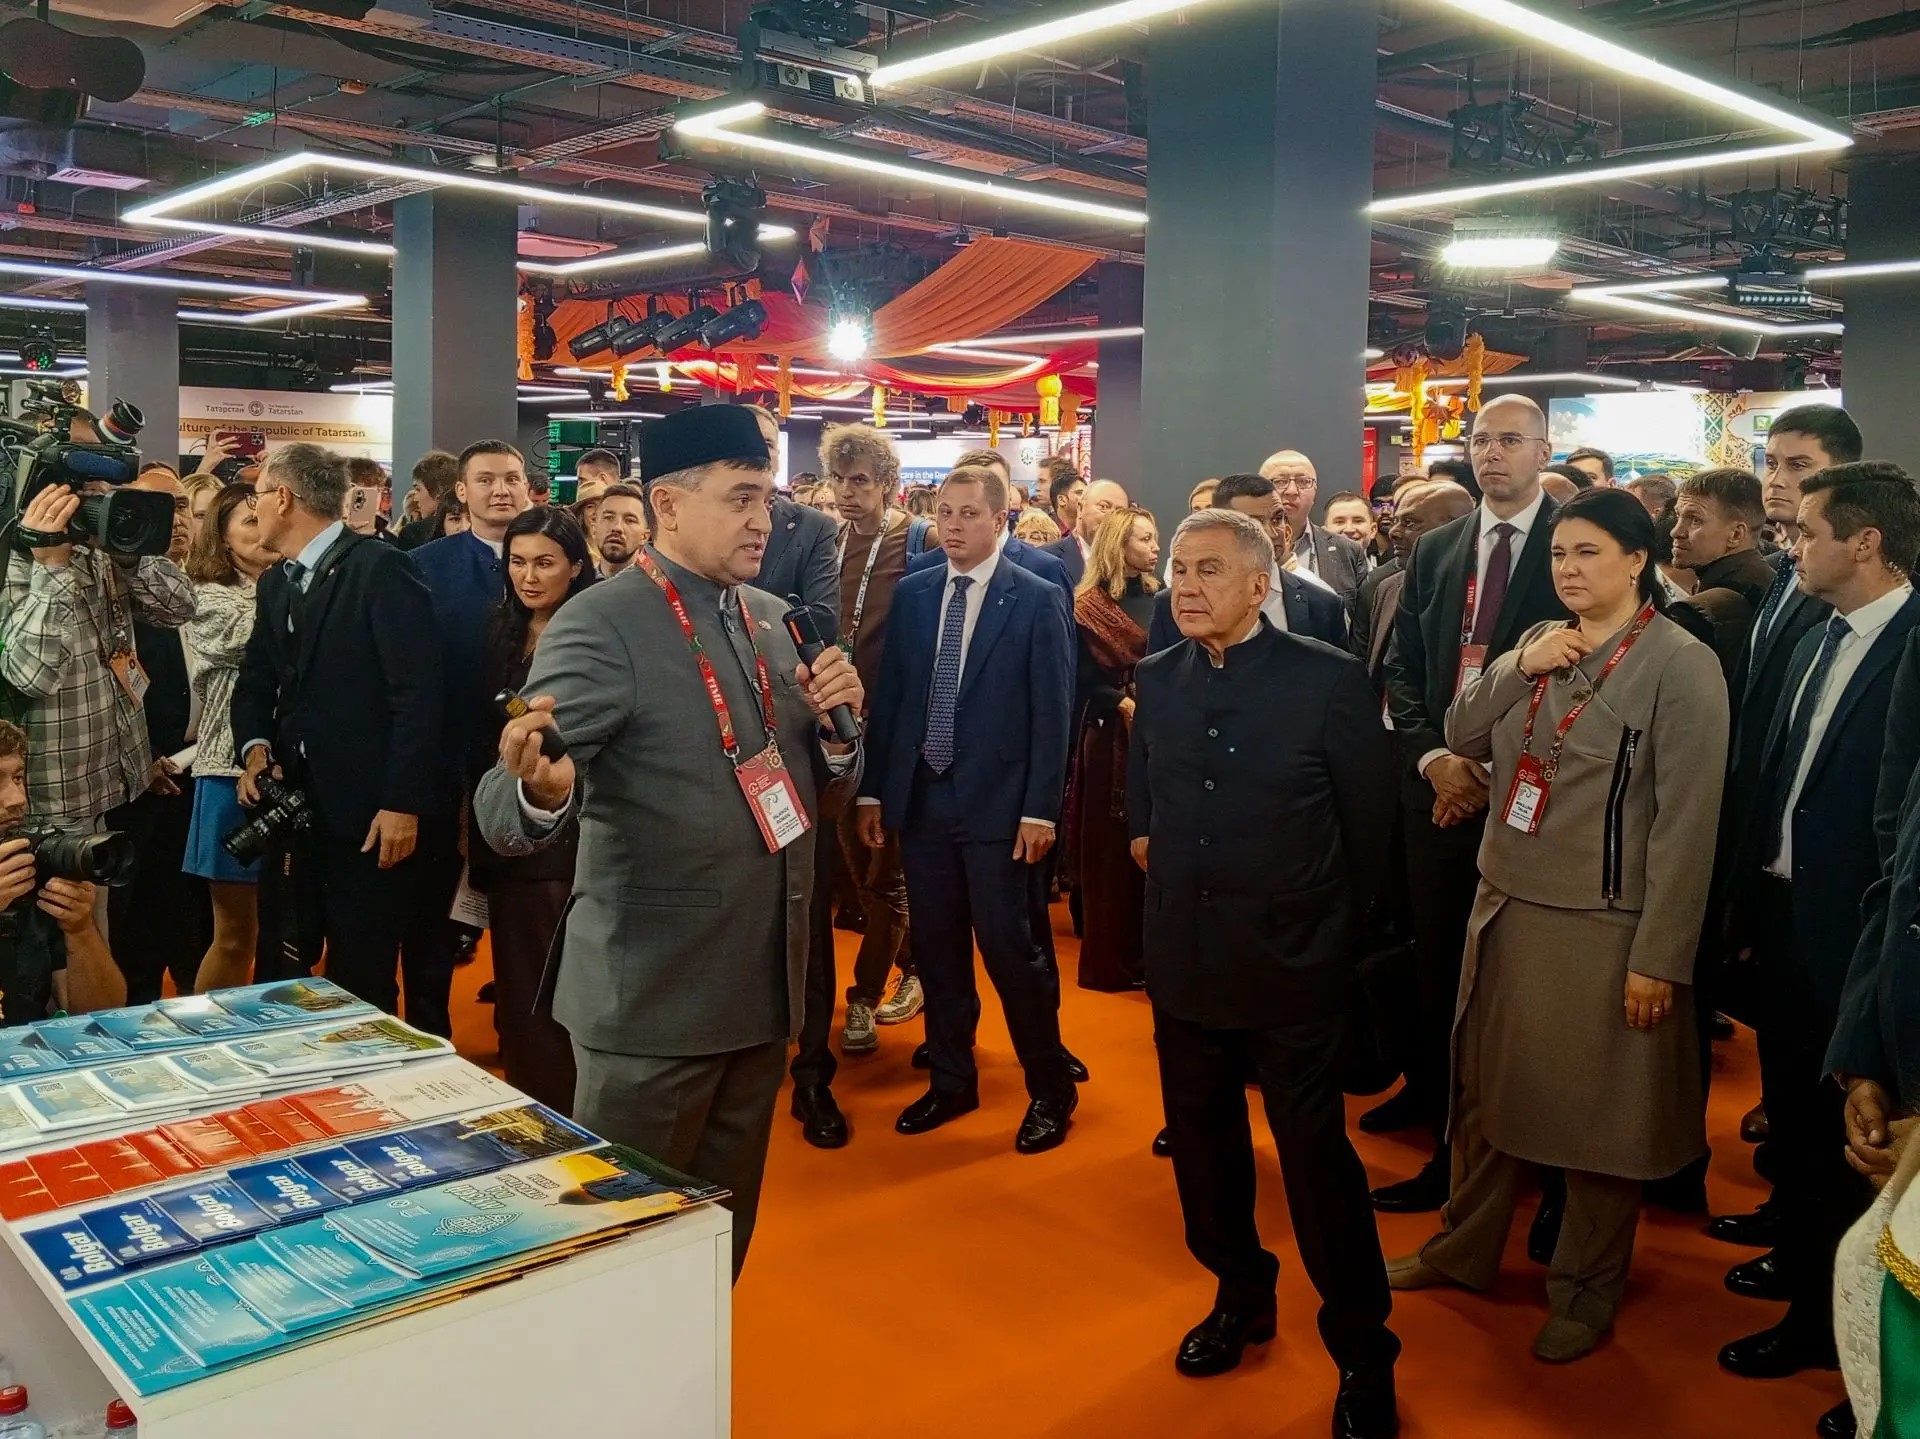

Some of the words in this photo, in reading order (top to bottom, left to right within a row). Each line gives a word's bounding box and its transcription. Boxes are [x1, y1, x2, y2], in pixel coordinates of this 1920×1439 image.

[205, 405, 245, 413] Татарстан
[268, 407, 304, 415] Tatarstan
[250, 425, 300, 437] Republic
[303, 426, 314, 436] of
[316, 427, 366, 438] Tatarstan
[672, 600, 690, 627] TIME
[1609, 646, 1628, 666] TIME
[706, 677, 724, 706] TIME
[330, 1159, 390, 1192] Bolgar
[380, 1145, 438, 1178] Bolgar
[266, 1174, 322, 1210] Bolgar
[190, 1193, 246, 1230] Bolgar
[119, 1213, 173, 1253] Bolgar
[62, 1230, 116, 1274] Bolgar
